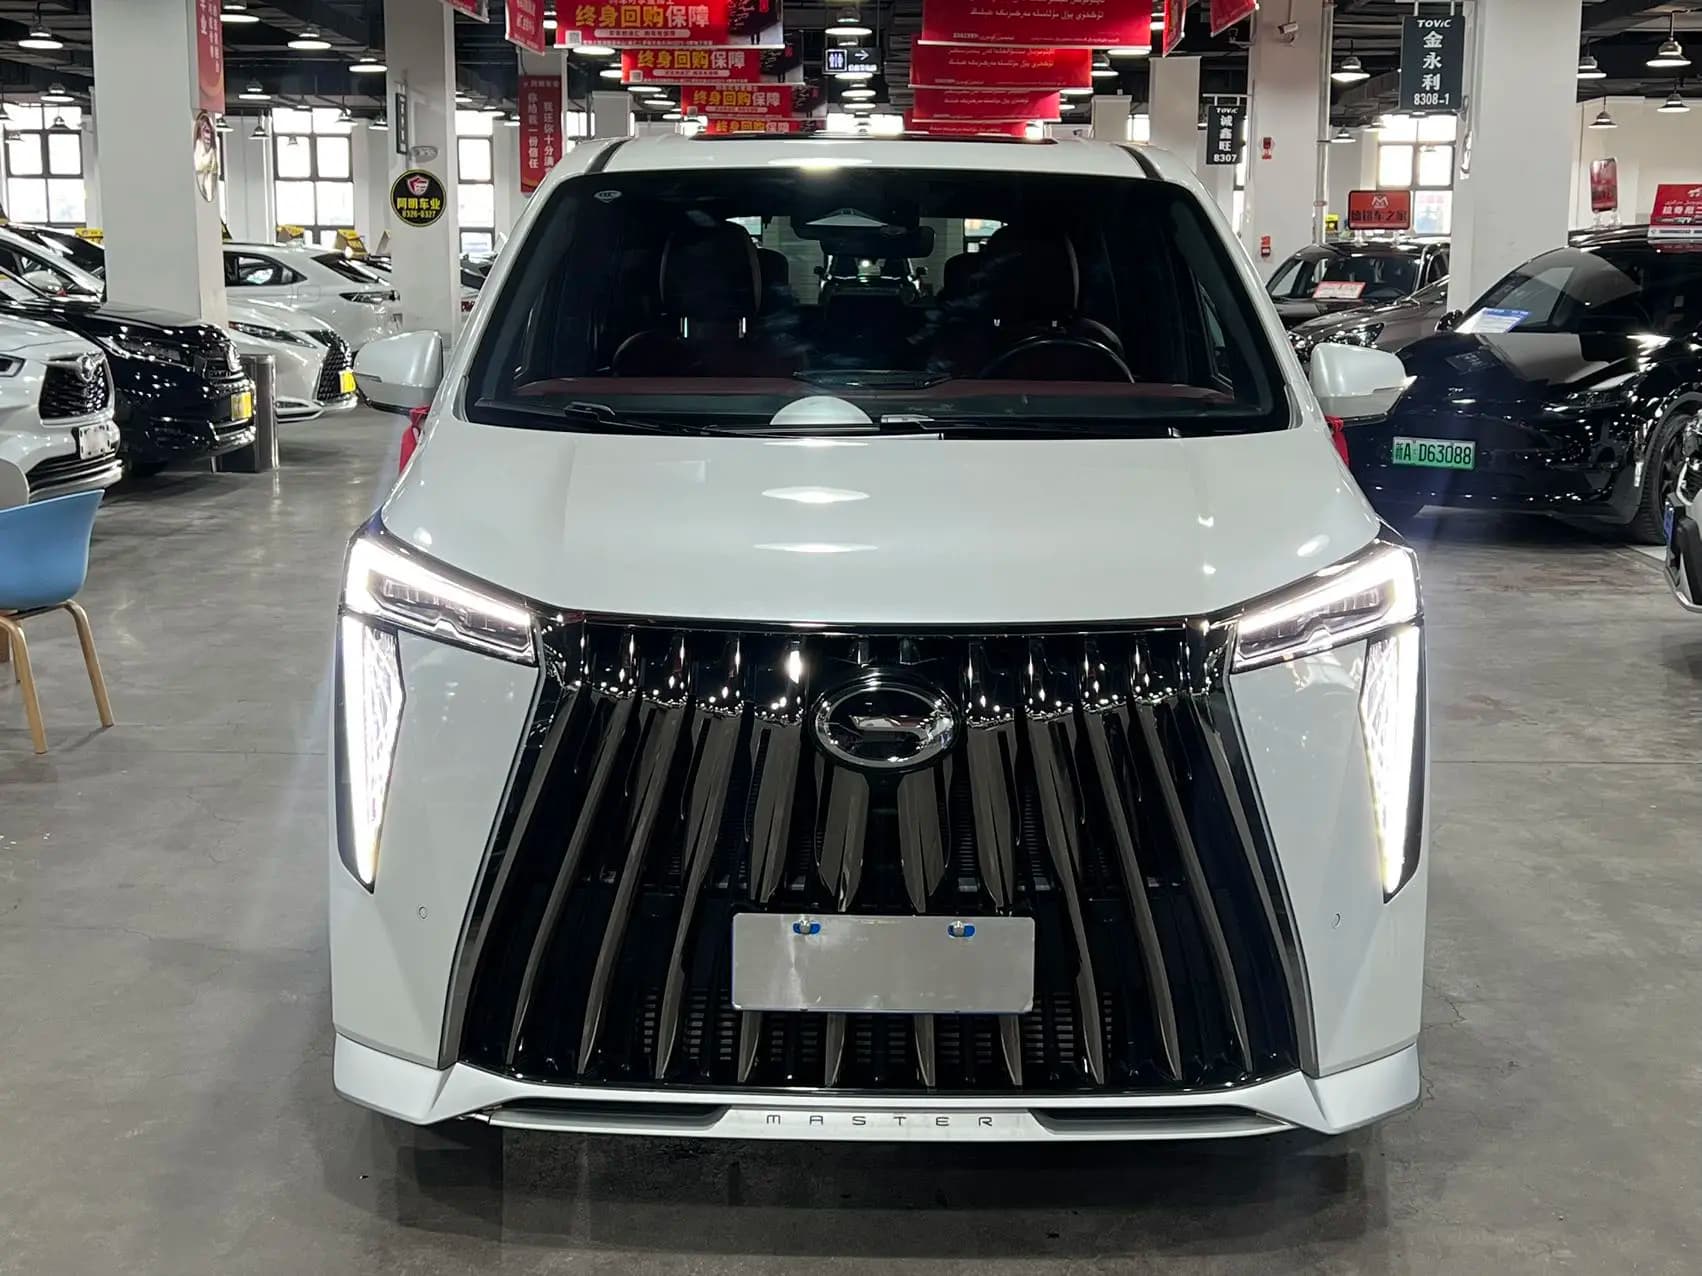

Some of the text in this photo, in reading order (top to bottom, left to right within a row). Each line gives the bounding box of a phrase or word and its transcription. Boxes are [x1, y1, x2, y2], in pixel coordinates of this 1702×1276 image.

[575, 5, 710, 28] 终身回购保障
[637, 51, 746, 69] 终身回购保障
[1421, 30, 1443, 91] 金永利
[693, 90, 781, 107] 终身回购保障
[1413, 93, 1450, 106] 8308-1
[1213, 153, 1237, 162] 8307
[766, 1114, 993, 1127] MASTER
